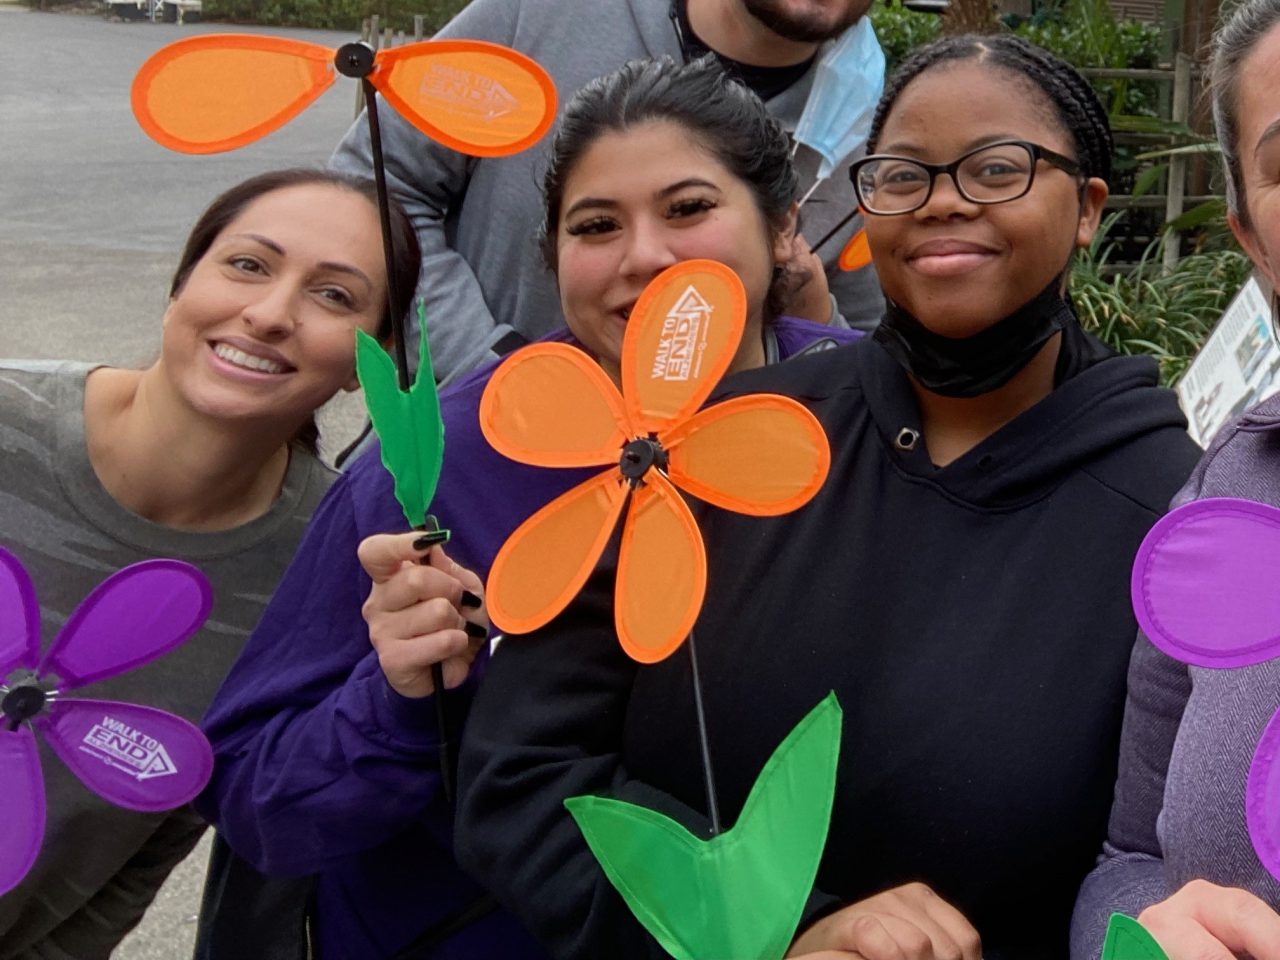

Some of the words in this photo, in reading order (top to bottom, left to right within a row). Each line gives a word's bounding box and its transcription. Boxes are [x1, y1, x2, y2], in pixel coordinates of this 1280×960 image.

[661, 317, 677, 337] TO
[651, 338, 673, 379] WALK
[666, 318, 691, 378] END
[91, 727, 148, 761] END
[102, 715, 142, 743] WALK
[140, 734, 159, 752] TO
